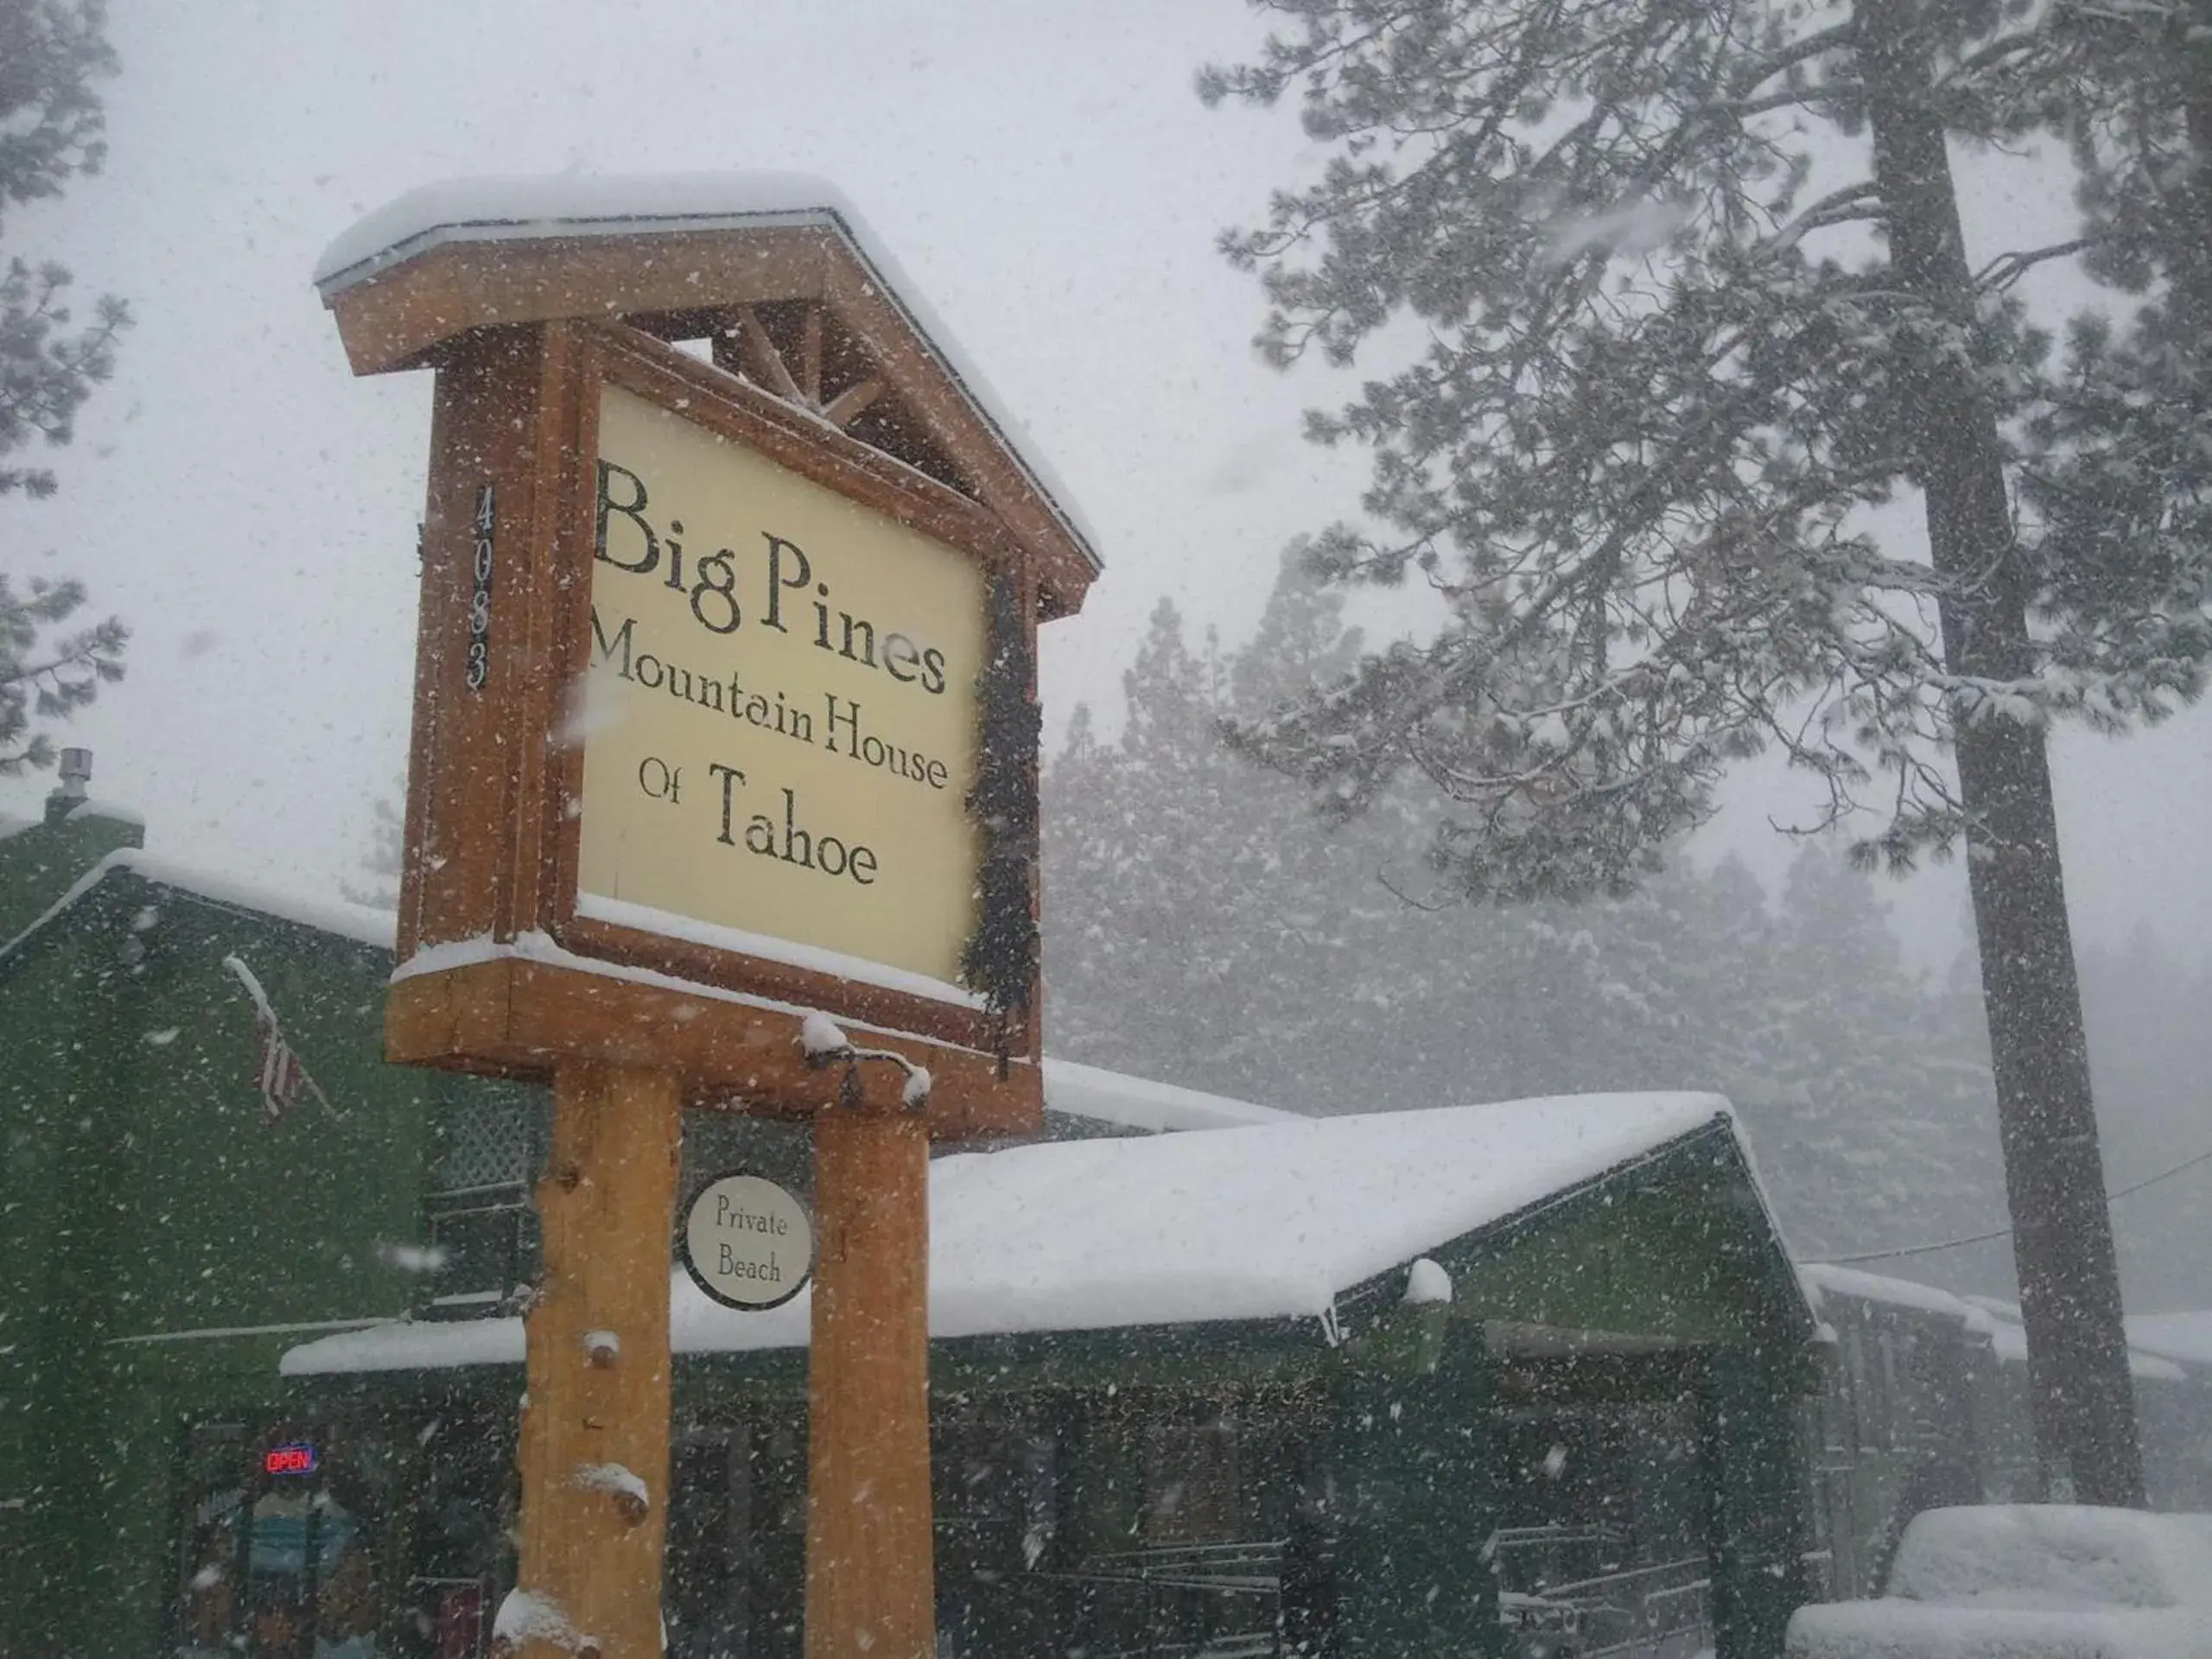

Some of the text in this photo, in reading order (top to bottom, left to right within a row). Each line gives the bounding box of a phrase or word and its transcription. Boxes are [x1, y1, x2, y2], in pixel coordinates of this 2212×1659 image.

[467, 485, 493, 690] 4083
[594, 458, 946, 695] Big Pines
[590, 604, 949, 789] Mountain House
[639, 756, 878, 885] Of Tahoe
[716, 1193, 788, 1236] Private
[718, 1242, 781, 1283] Beach
[266, 1450, 308, 1472] OPEN
